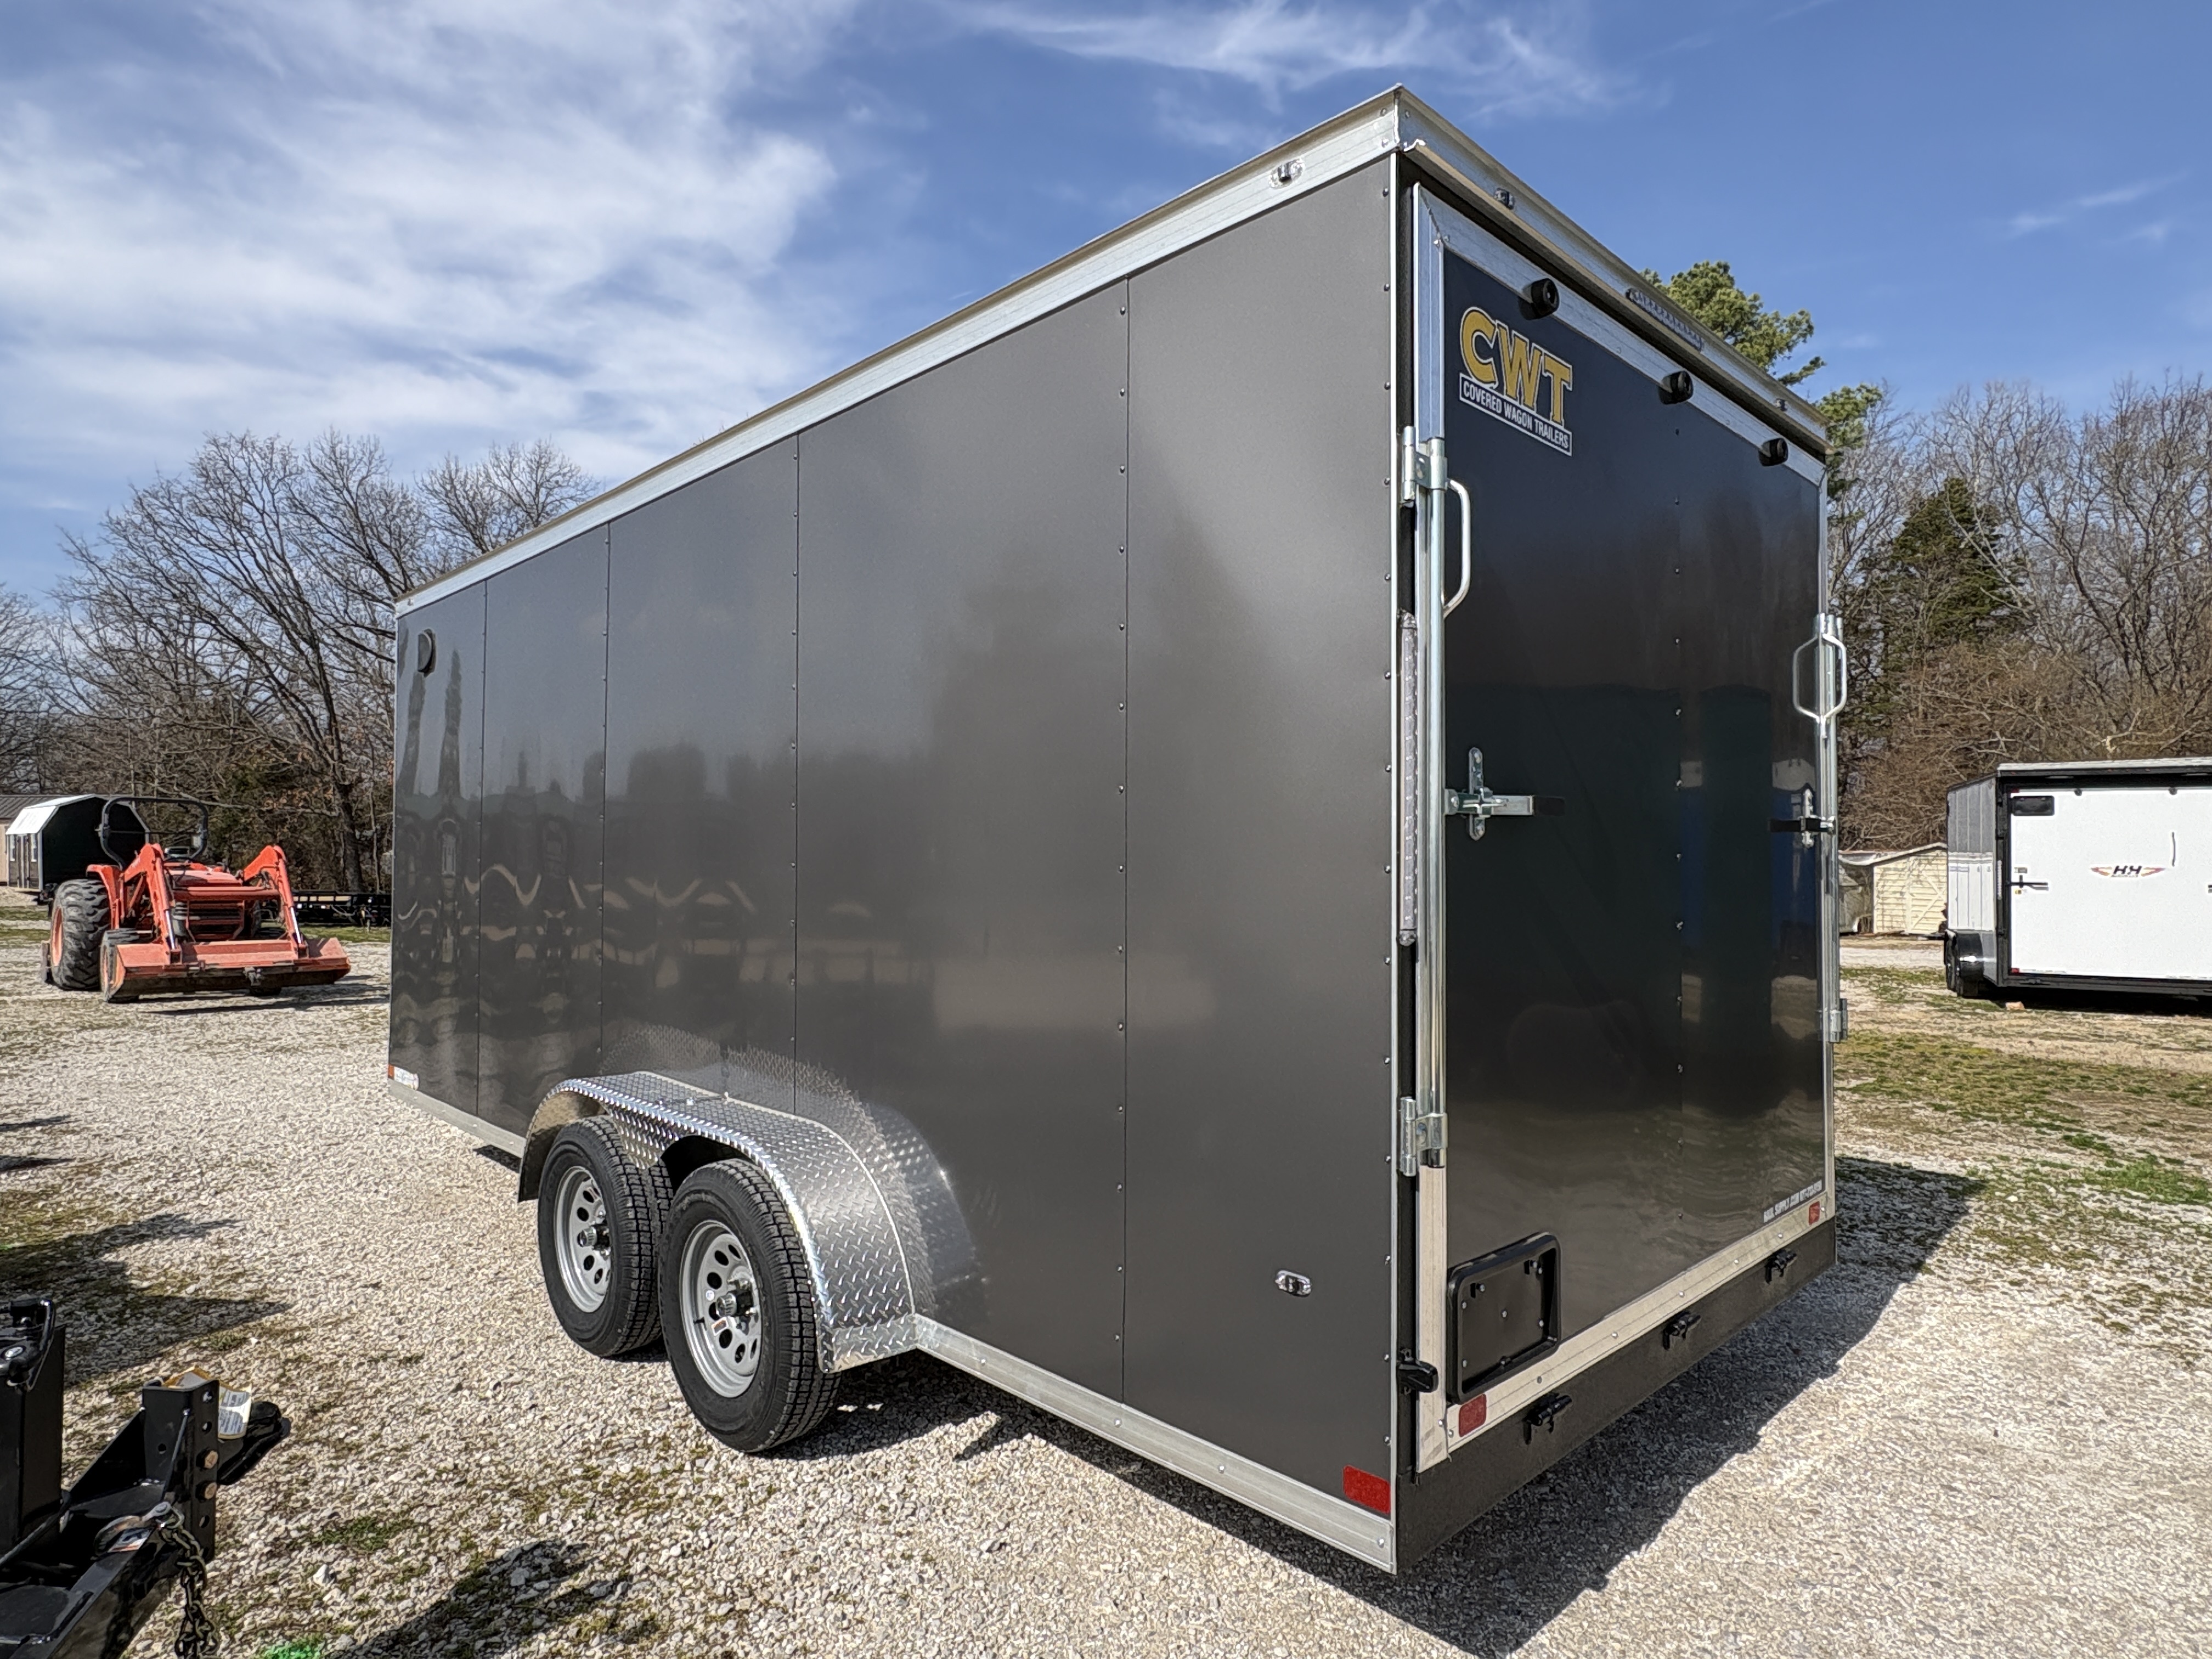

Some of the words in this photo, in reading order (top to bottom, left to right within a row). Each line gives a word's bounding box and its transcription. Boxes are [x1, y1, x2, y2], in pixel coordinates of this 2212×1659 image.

[1459, 306, 1572, 429] CWT
[1463, 381, 1502, 414] COVERED
[1504, 402, 1533, 431] WAGON
[1534, 419, 1569, 449] TRAILERS
